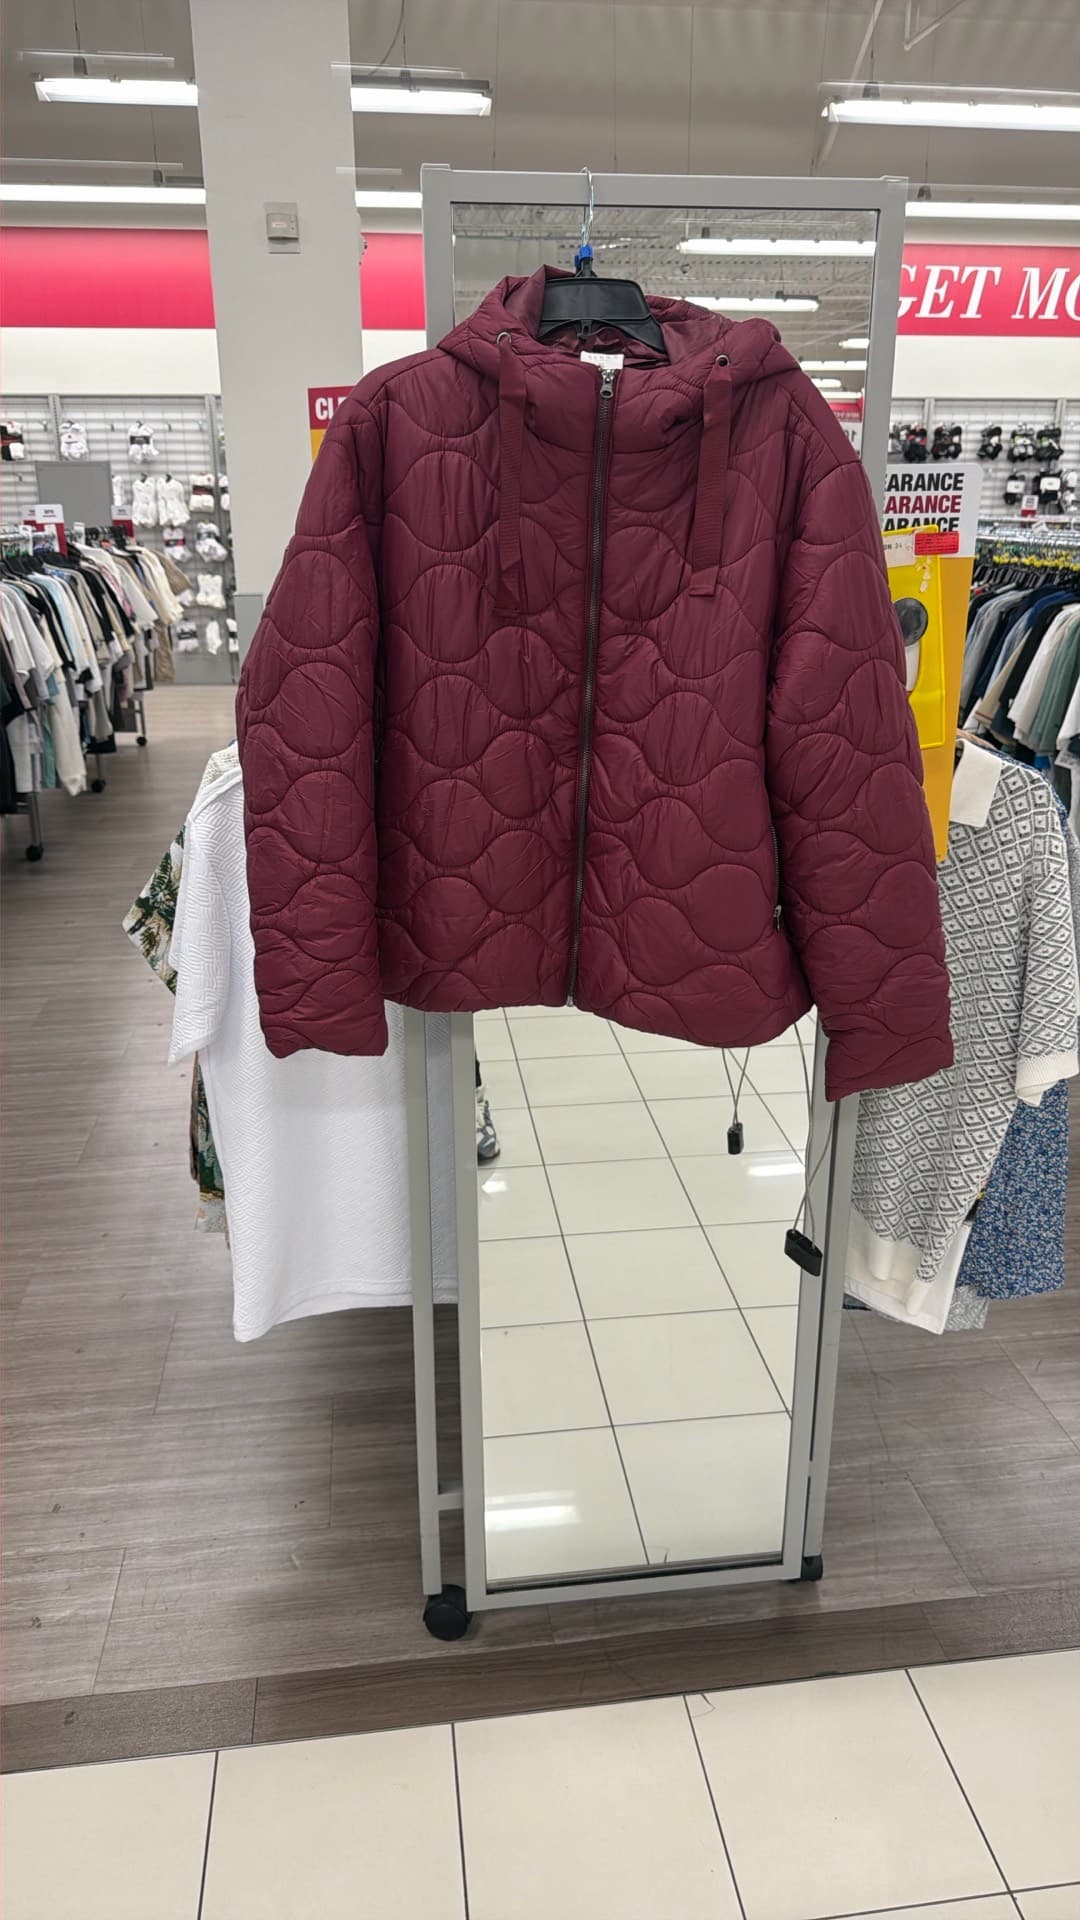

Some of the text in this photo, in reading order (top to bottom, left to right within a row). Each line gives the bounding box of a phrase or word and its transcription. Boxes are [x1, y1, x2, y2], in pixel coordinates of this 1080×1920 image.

[315, 396, 348, 420] CL
[884, 472, 964, 492] ARANCE
[883, 495, 962, 514] ARANCE
